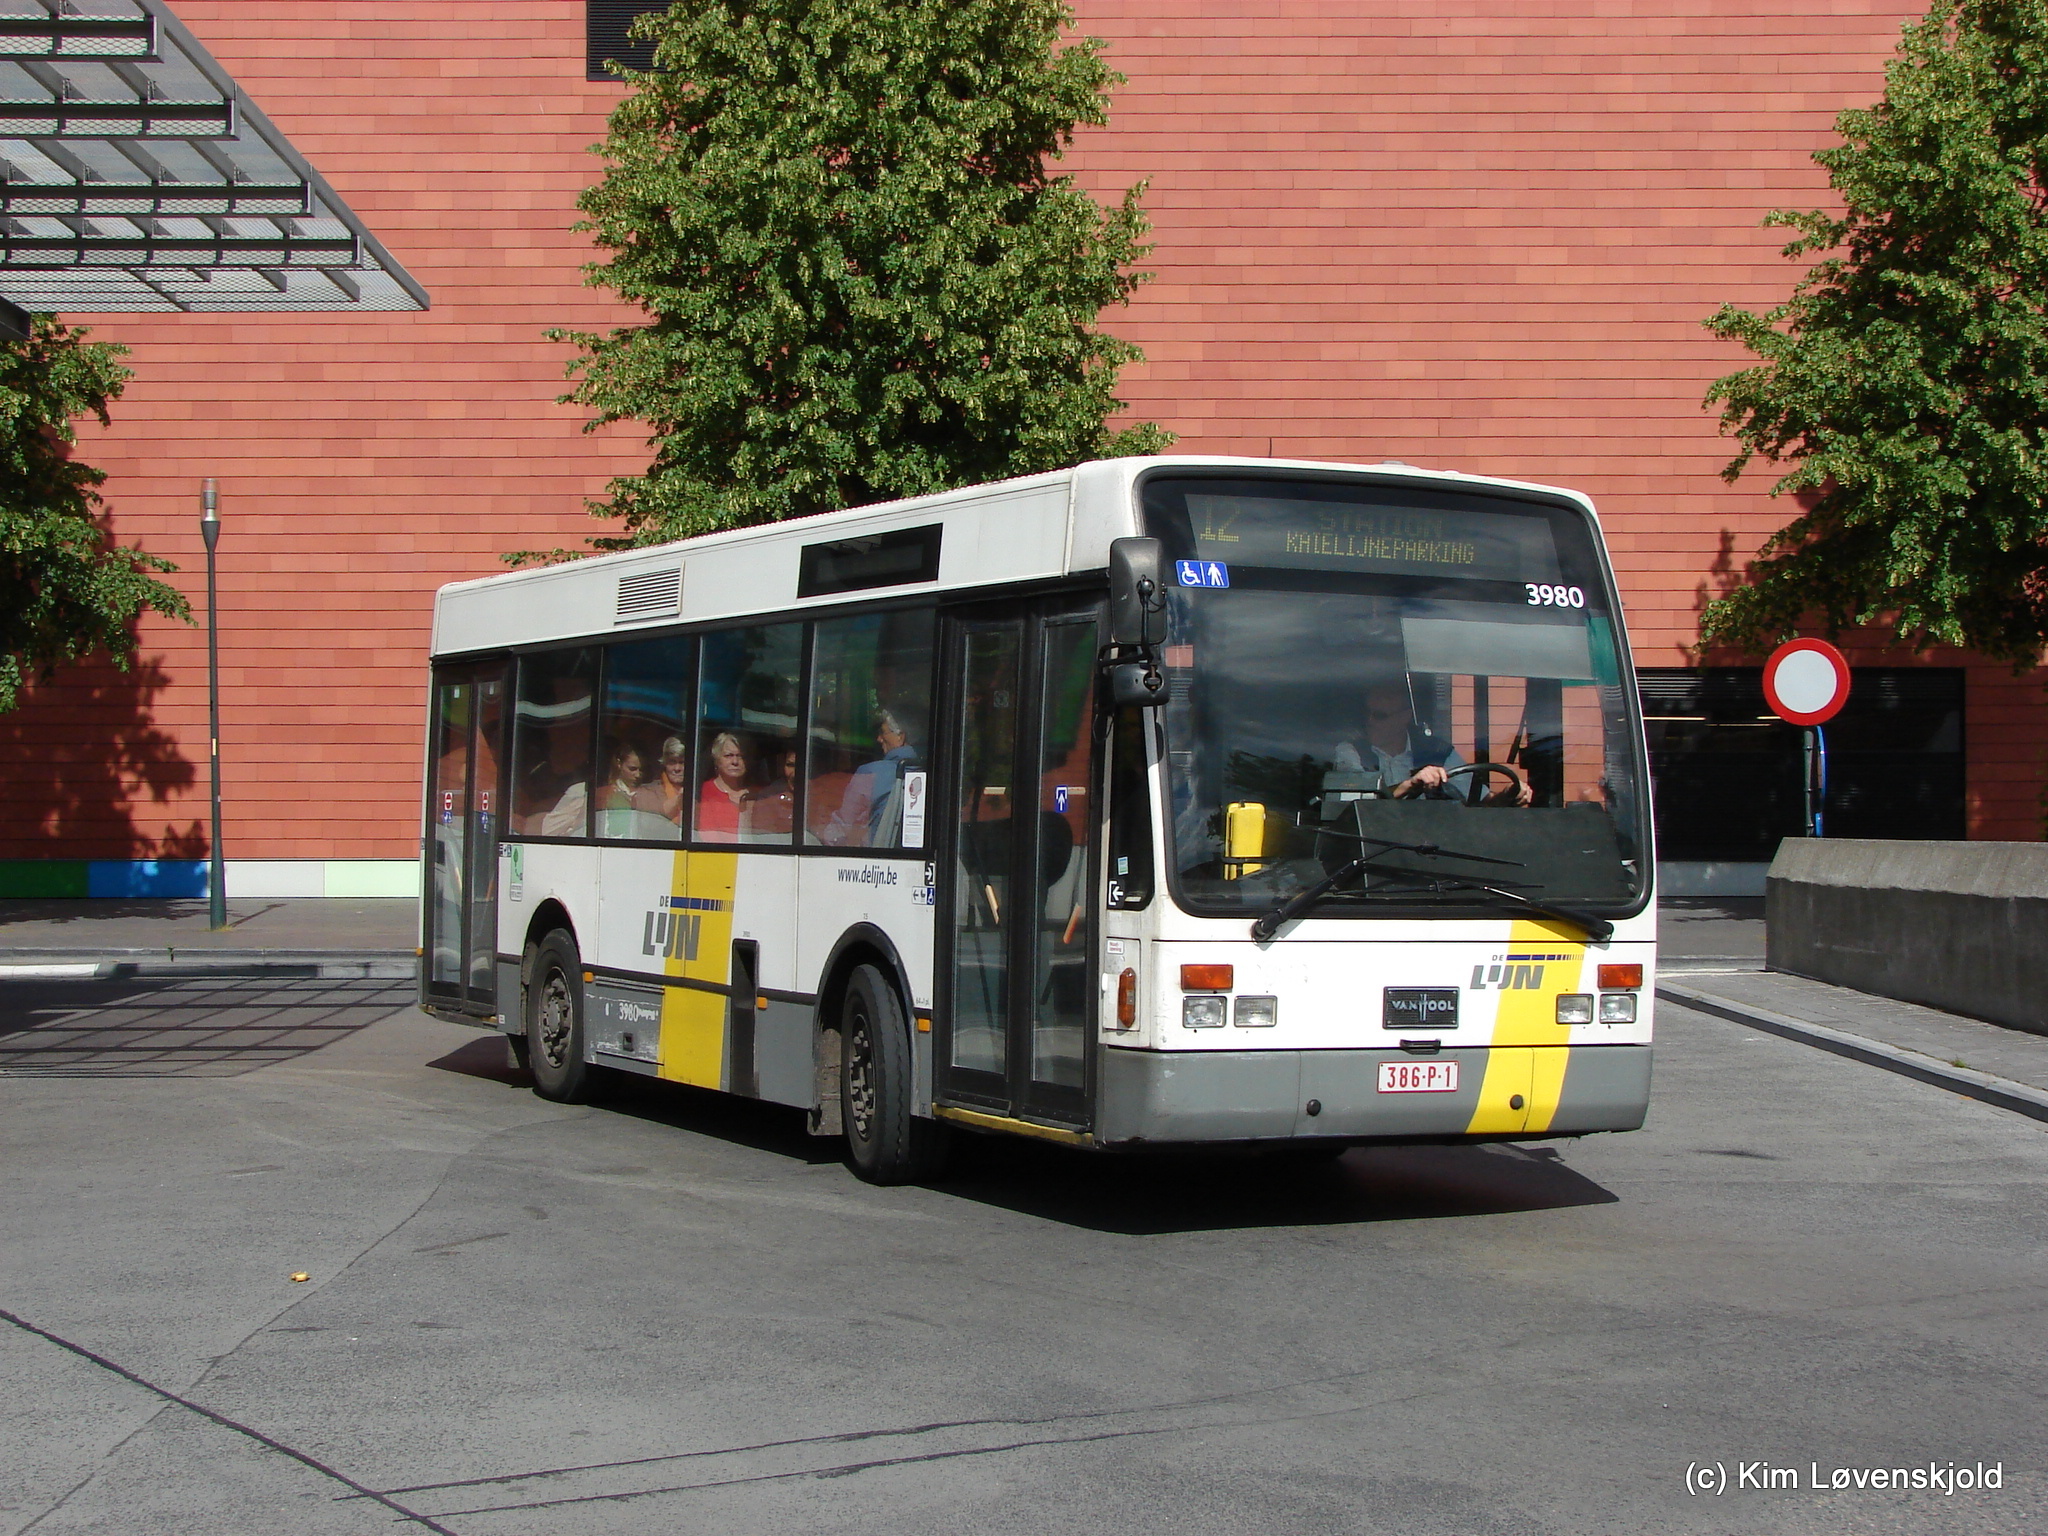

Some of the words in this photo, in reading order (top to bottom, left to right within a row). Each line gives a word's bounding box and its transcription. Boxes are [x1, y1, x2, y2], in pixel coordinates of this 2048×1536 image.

[1524, 583, 1585, 609] 3980
[837, 864, 898, 889] www.delijn.be
[659, 895, 670, 908] DE
[642, 910, 702, 962] LIJN
[1491, 954, 1505, 962] DE
[1469, 965, 1545, 990] LIJN
[618, 1002, 639, 1022] 3980
